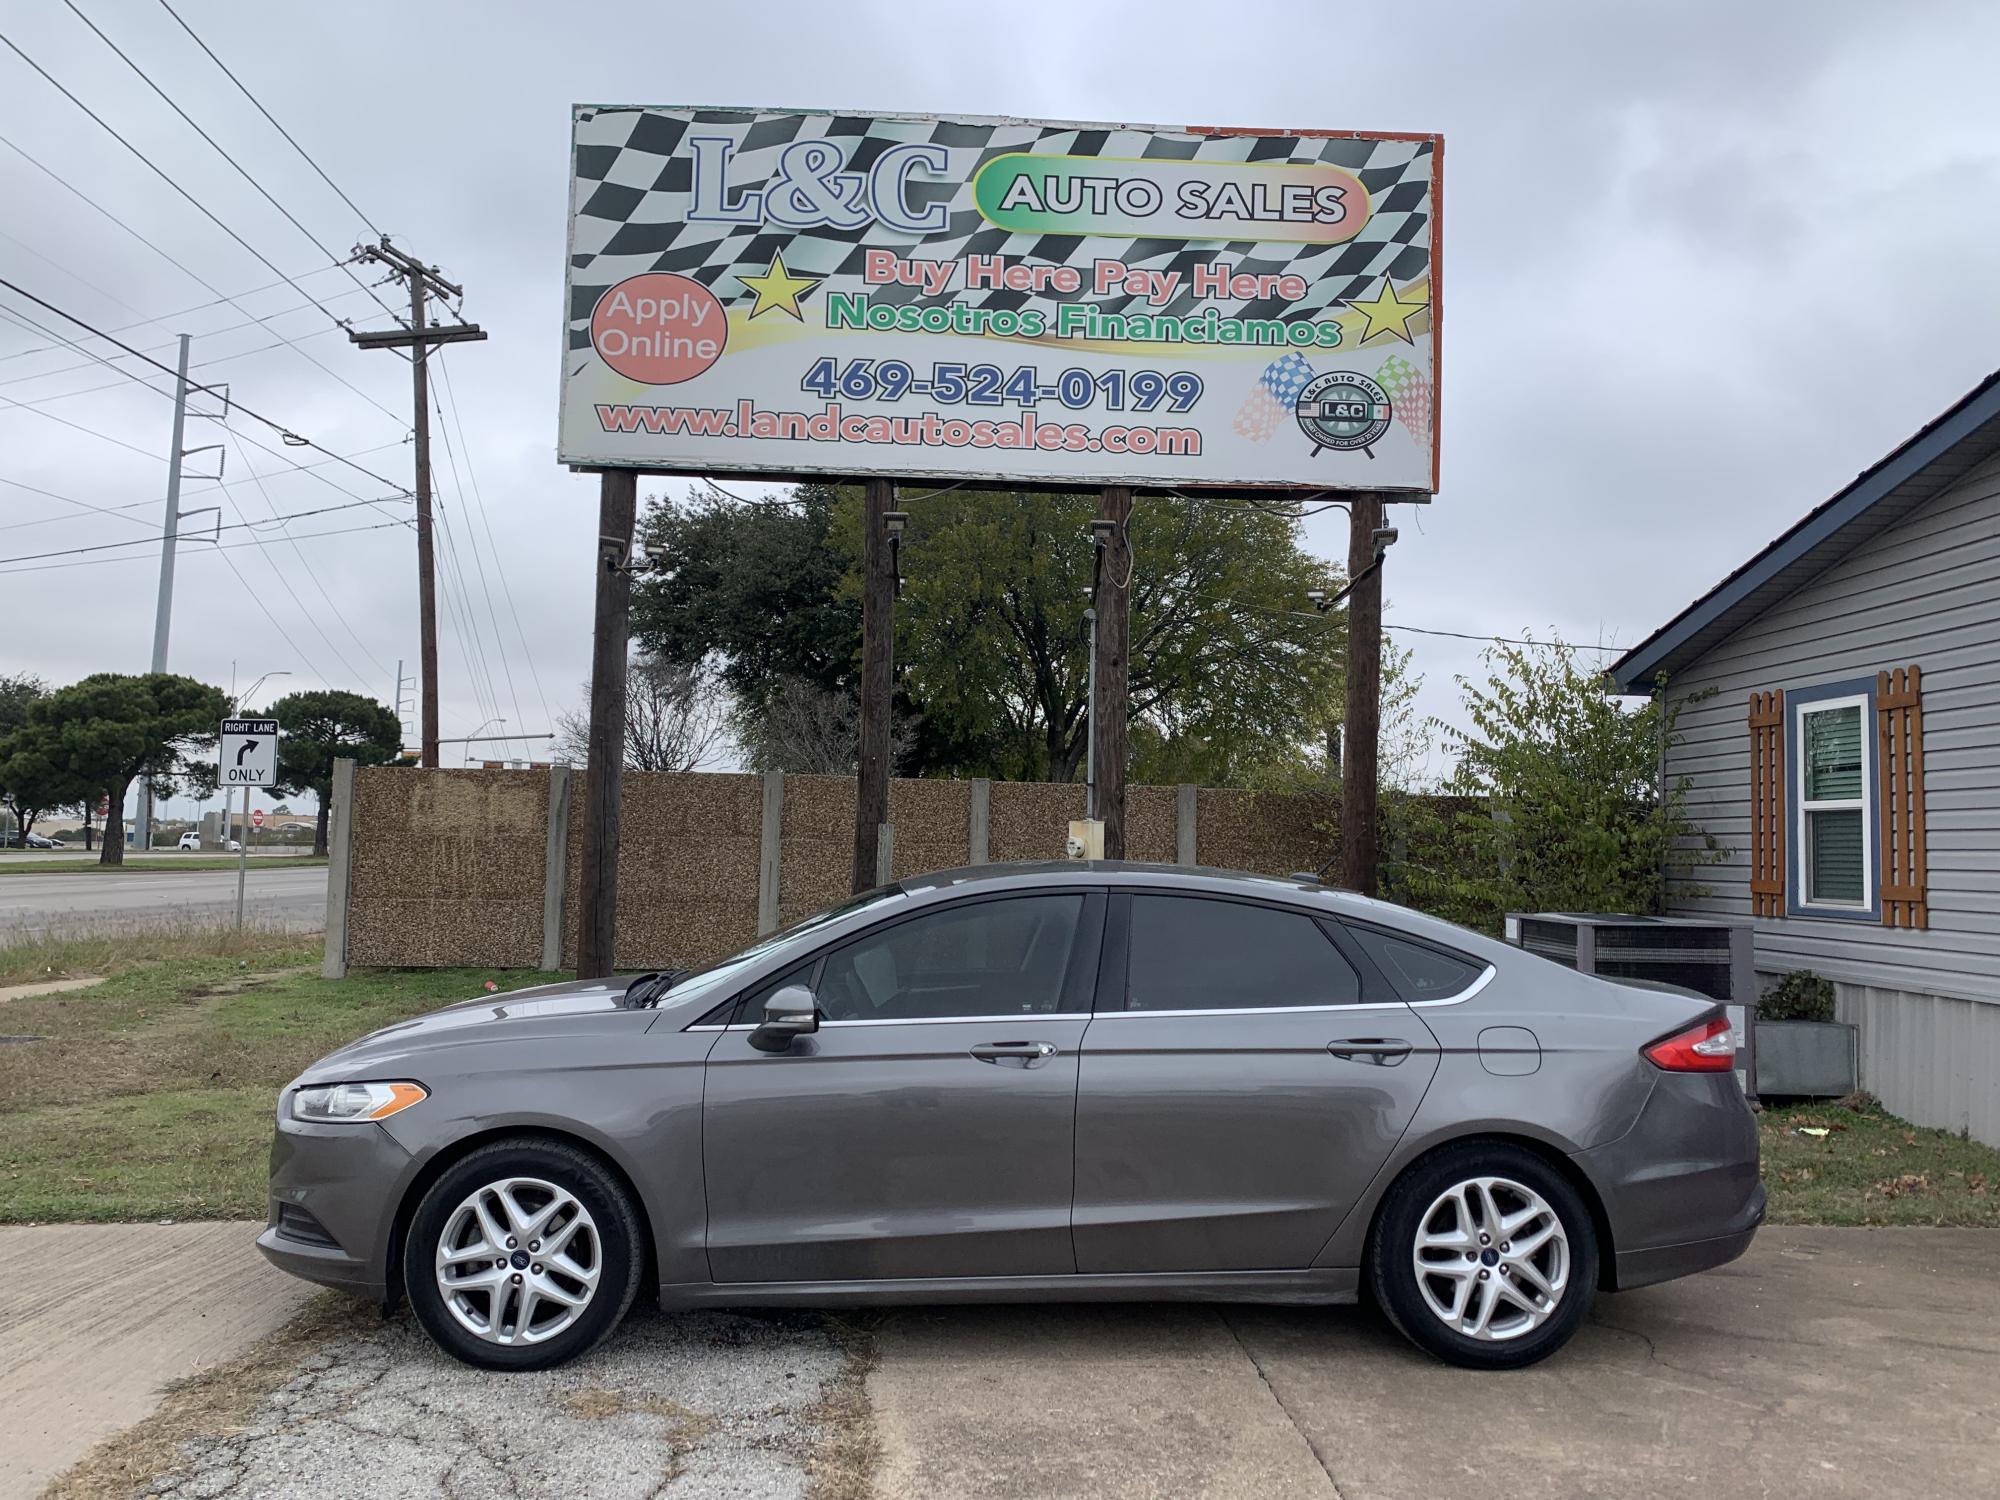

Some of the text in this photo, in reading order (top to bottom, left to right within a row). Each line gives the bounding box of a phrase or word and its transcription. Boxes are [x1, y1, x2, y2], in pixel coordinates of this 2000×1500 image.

[685, 136, 1348, 232] L&C AUTO SALES
[864, 249, 1308, 306] Buy Here Pay Here
[606, 291, 712, 327] Apply
[826, 291, 1344, 348] Nosotros Financiamos
[598, 330, 718, 360] Online
[801, 356, 1204, 414] 469-524-0199
[1304, 375, 1384, 402] L&C AUTO SALES
[594, 398, 1203, 457] www.landcautosales.com
[1324, 403, 1364, 418] L&C
[225, 723, 275, 733] RIGHT LANE
[228, 769, 265, 782] ONLY
